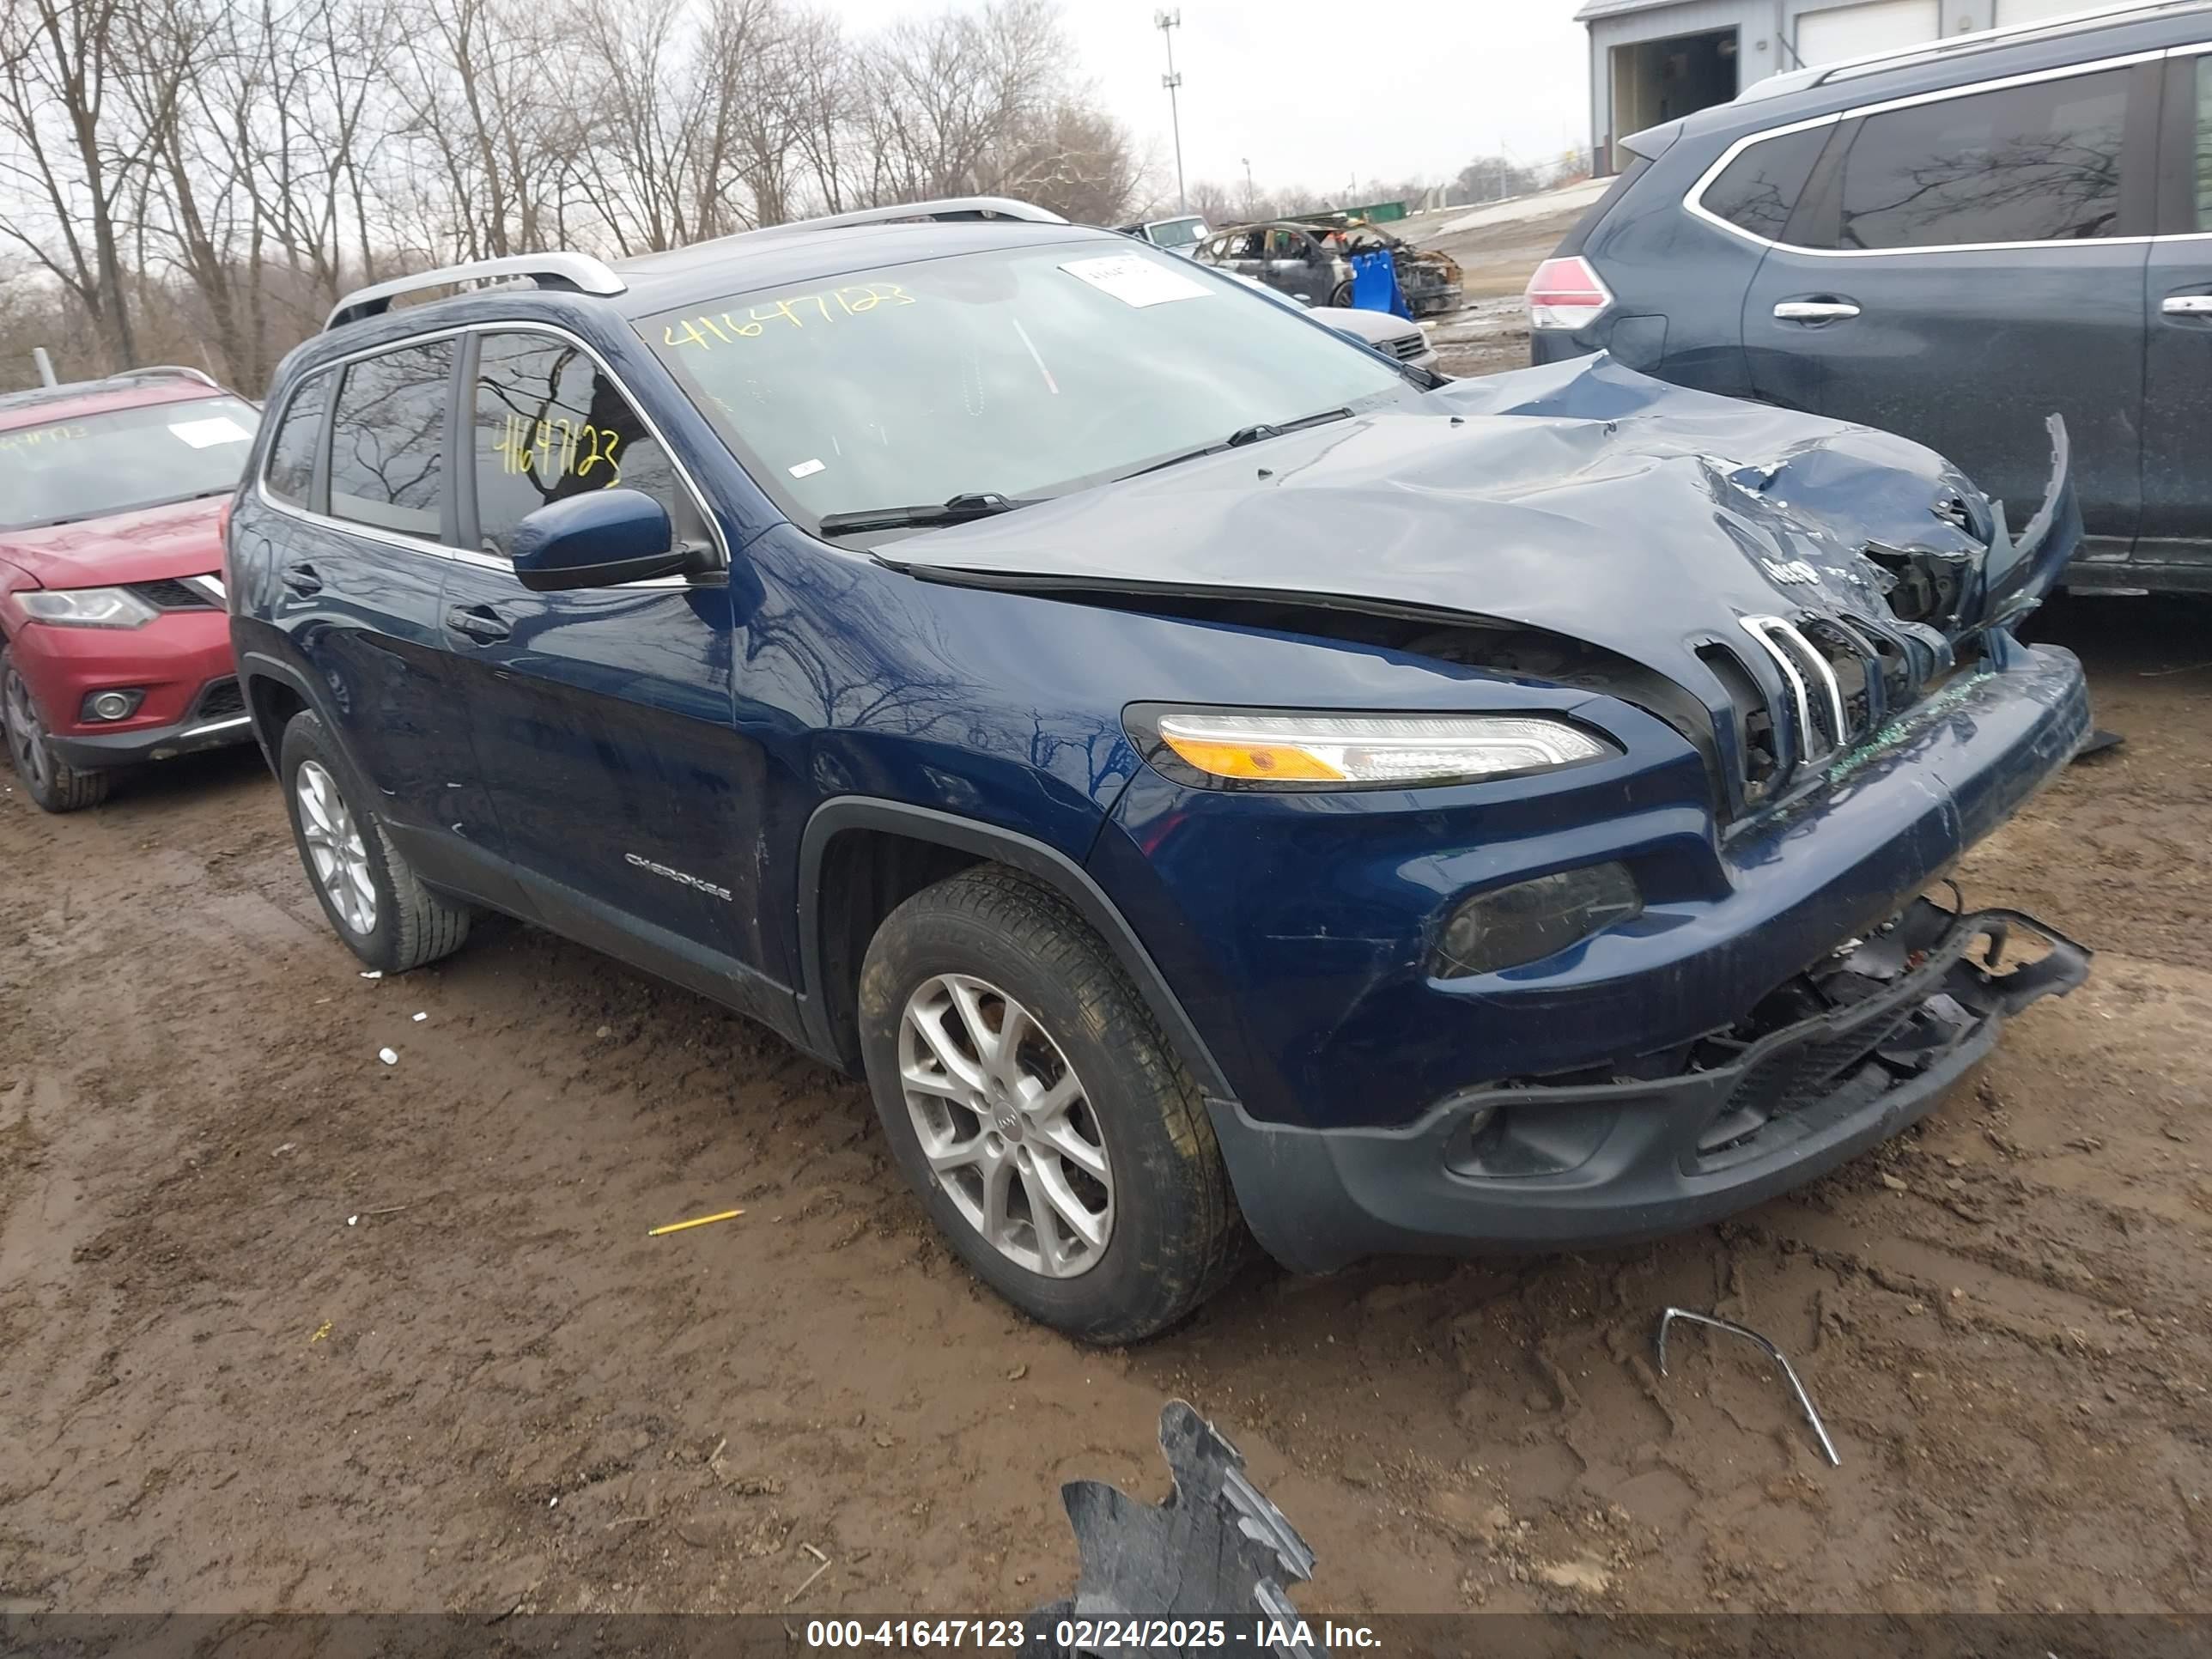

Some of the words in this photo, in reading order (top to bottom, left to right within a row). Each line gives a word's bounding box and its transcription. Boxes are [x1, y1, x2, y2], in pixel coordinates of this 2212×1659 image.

[663, 282, 916, 351] 41647123
[492, 414, 623, 489] 41647123
[624, 852, 733, 902] CHEROKEE
